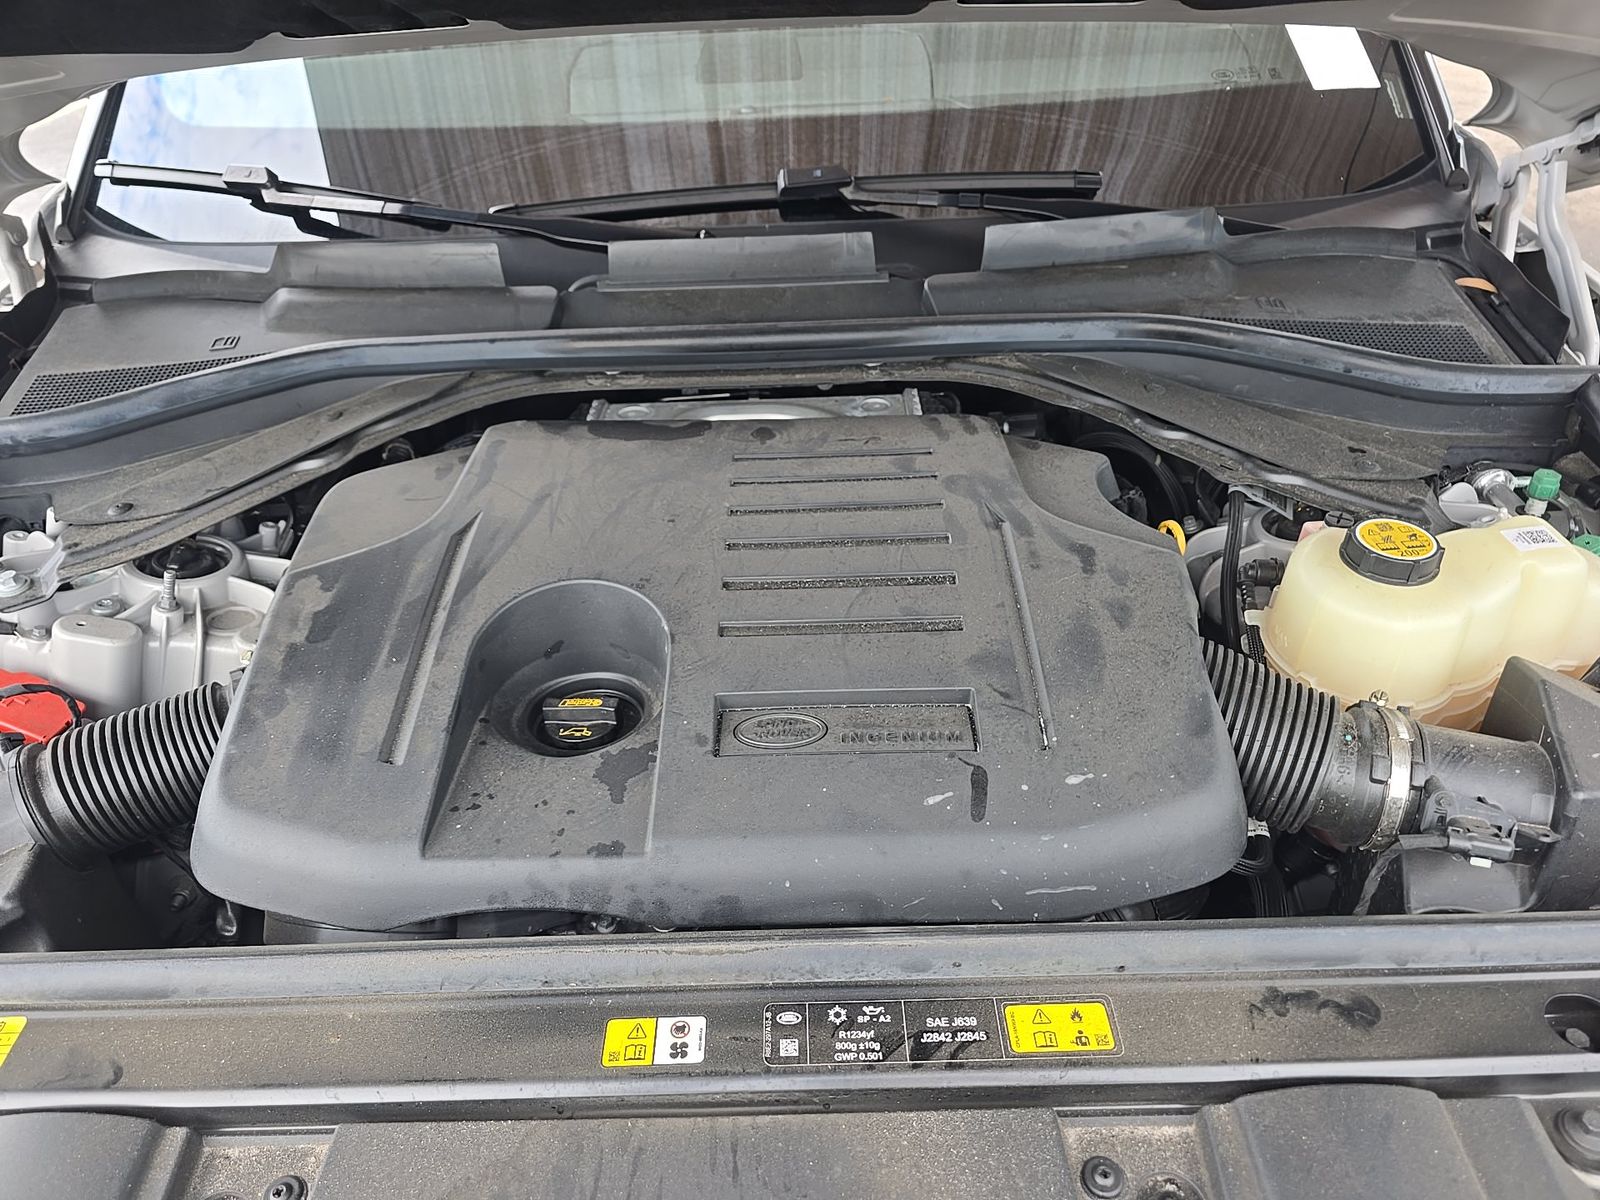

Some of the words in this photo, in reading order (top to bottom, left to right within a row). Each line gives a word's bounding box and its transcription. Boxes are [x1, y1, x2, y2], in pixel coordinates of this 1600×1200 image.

[839, 729, 963, 746] INGENIUM
[857, 1015, 871, 1023] SP
[879, 1015, 892, 1023] A2
[926, 1017, 950, 1028] SAE
[951, 1016, 978, 1027] J639
[838, 1030, 875, 1039] R1234yf
[920, 1032, 953, 1043] J2842
[954, 1031, 988, 1042] J2845
[835, 1042, 858, 1051] 800g
[858, 1041, 881, 1051] ±10g
[834, 1053, 858, 1061] GWP
[859, 1052, 883, 1061] 0.501
